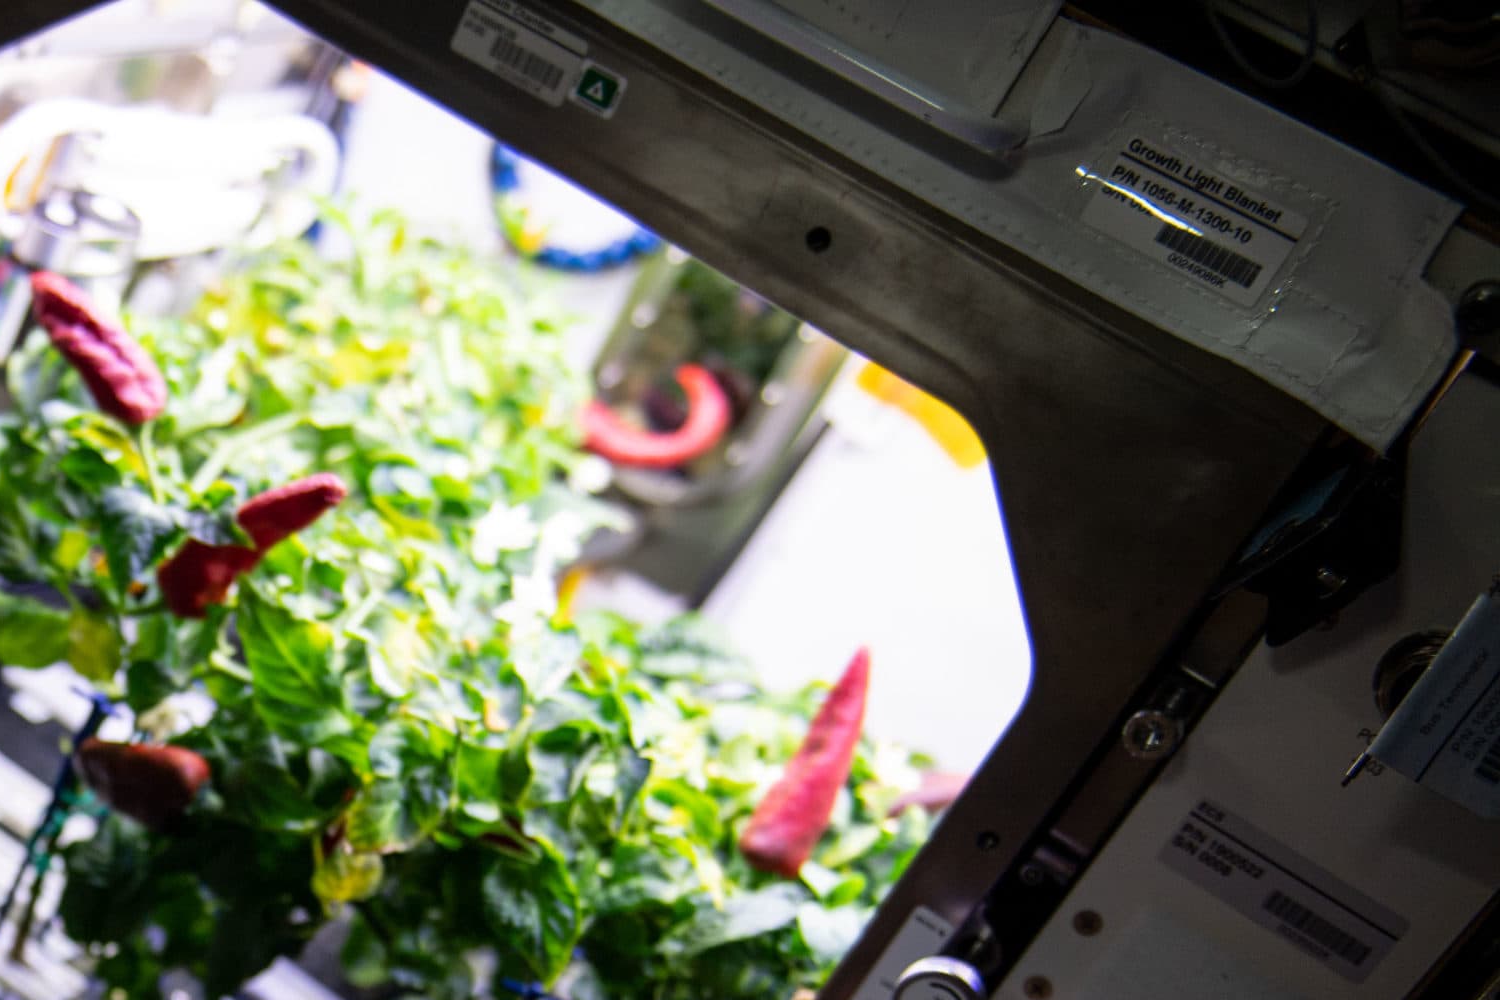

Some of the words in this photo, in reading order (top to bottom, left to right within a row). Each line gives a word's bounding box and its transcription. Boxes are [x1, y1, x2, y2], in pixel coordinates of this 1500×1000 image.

[1111, 165, 1141, 187] P/N
[1142, 180, 1253, 244] 1056-M-1300-10
[1129, 138, 1182, 175] Growth
[1184, 165, 1223, 195] Light
[1224, 183, 1282, 223] Blanket
[1420, 713, 1442, 736] Bus
[1182, 822, 1207, 844] P/N
